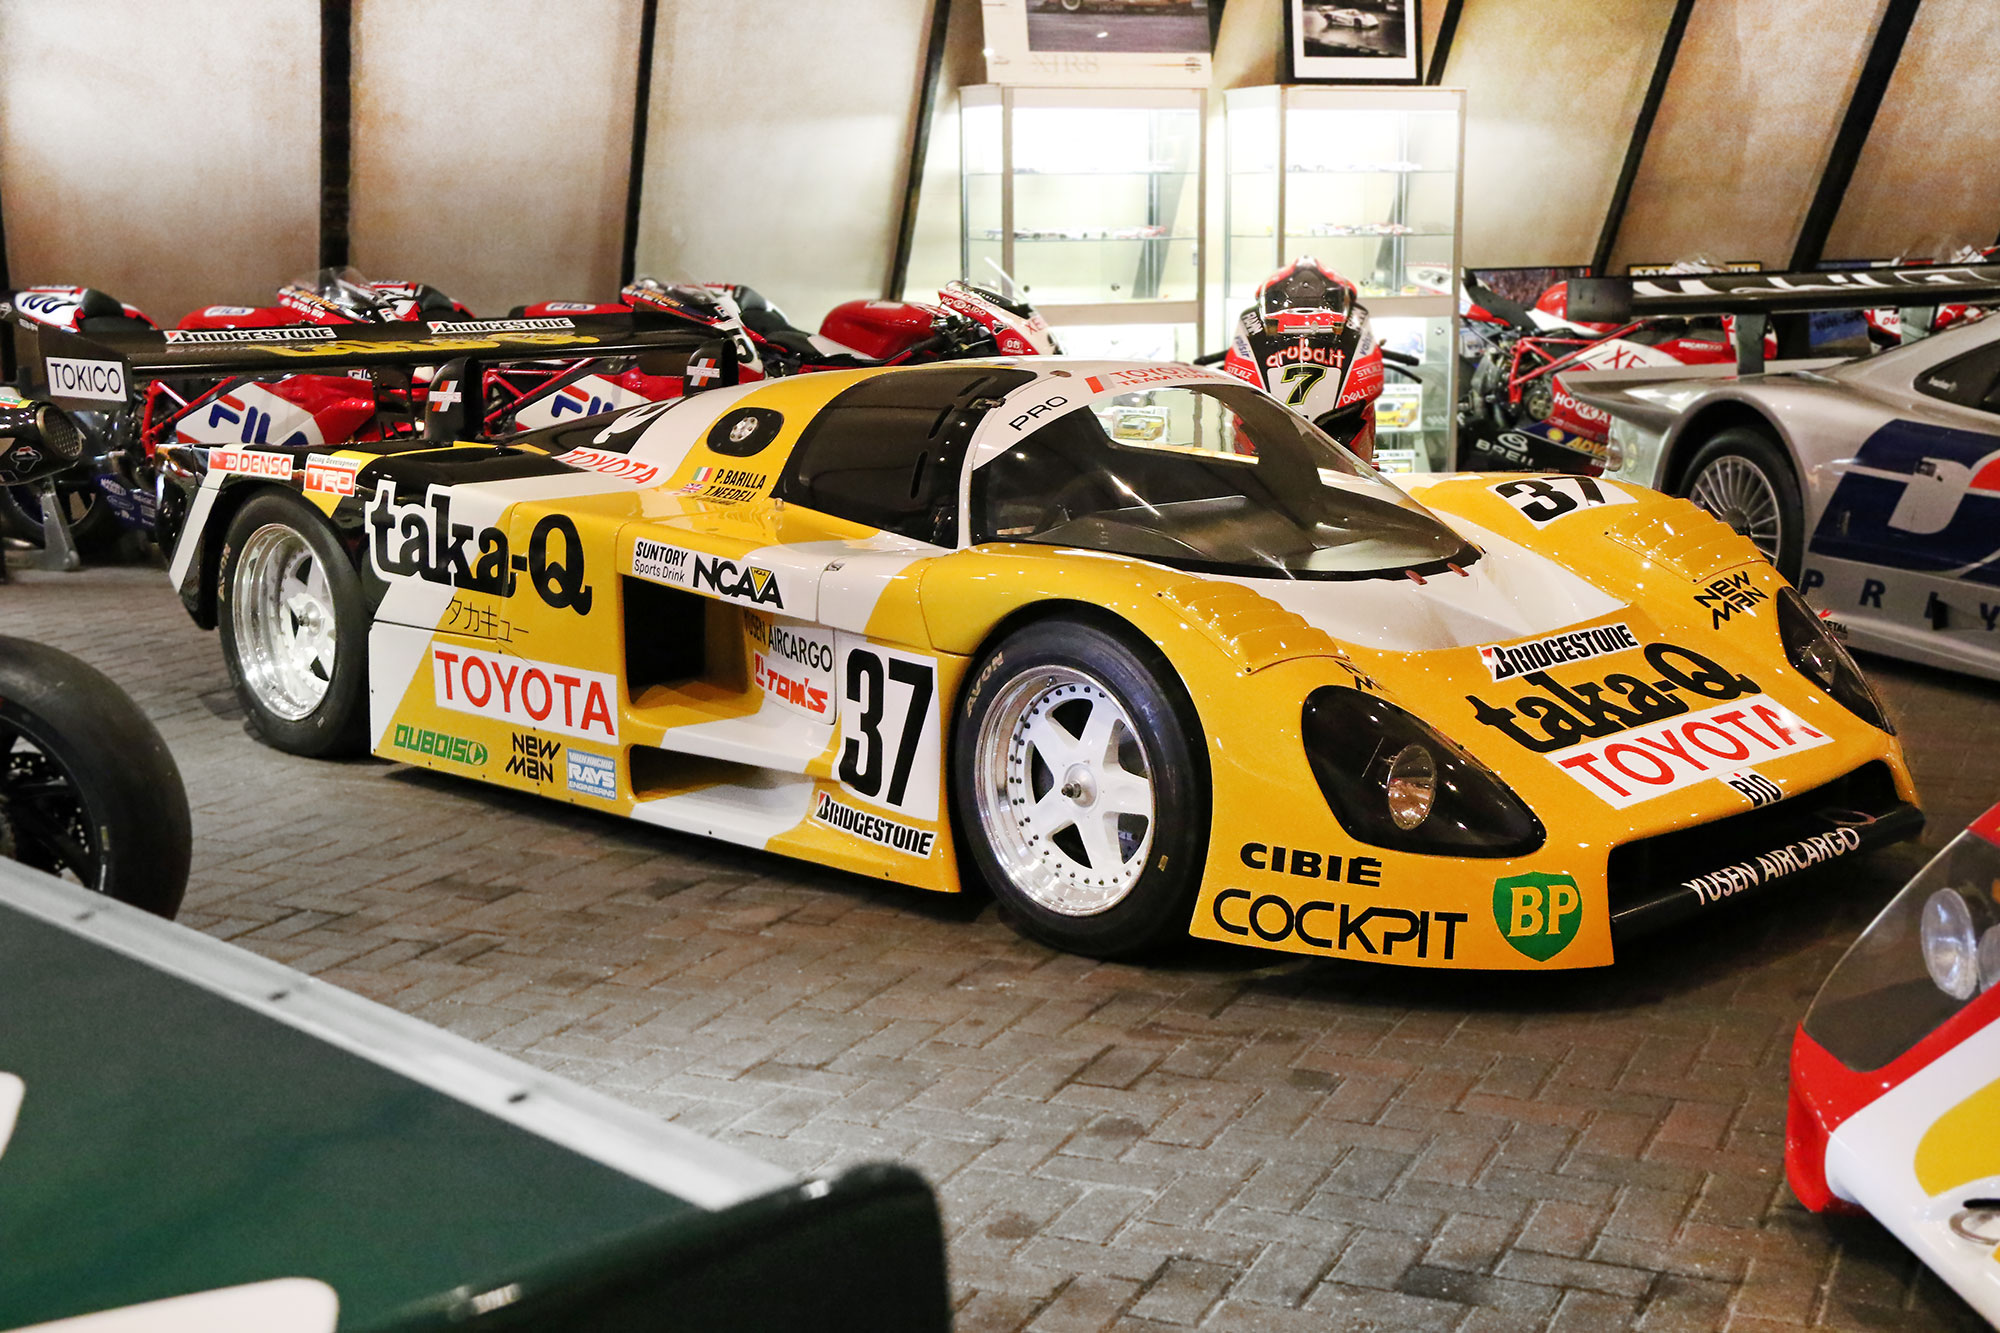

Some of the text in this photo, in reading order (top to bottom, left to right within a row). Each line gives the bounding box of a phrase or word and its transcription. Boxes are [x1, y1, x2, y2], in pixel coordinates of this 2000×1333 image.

[165, 328, 336, 344] BRIDGESTONE
[428, 319, 574, 335] BRIDGESTONE
[1109, 366, 1200, 380] TOYOTA
[1266, 338, 1346, 368] aruba.it
[51, 363, 122, 394] TOKICO
[1117, 375, 1172, 386] TEAM
[1281, 365, 1327, 406] 7
[1009, 396, 1068, 431] PRO
[239, 453, 292, 478] DENSO
[308, 455, 359, 468] Racing Development
[308, 468, 354, 494] TRD
[562, 450, 659, 485] TOYOTA
[714, 468, 767, 490] P.BARILLA
[703, 485, 756, 502] T.NEEDELL
[1495, 476, 1606, 522] 37
[370, 486, 593, 616] taka-Q
[634, 559, 686, 583] Sports Drink
[635, 541, 688, 567] SUNTORY
[693, 554, 785, 609] NCAA
[446, 596, 530, 643] タカキュー
[768, 624, 833, 673] AIRCARGO
[1483, 624, 1639, 680] BRIDGESTONE
[435, 650, 615, 736] TOYOTA
[767, 667, 828, 714] TOM'S
[967, 651, 1005, 719] AVON
[1465, 642, 1763, 753] taka-Q
[838, 648, 934, 808] 37
[1557, 704, 1825, 798] TOYOTA
[568, 762, 615, 788] RAYS
[818, 790, 935, 856] BRIDGESTONE
[1681, 827, 1861, 905] YUSEN AIRCARGO
[1213, 888, 1468, 960] COCKPIT
[1507, 884, 1578, 938] BP
